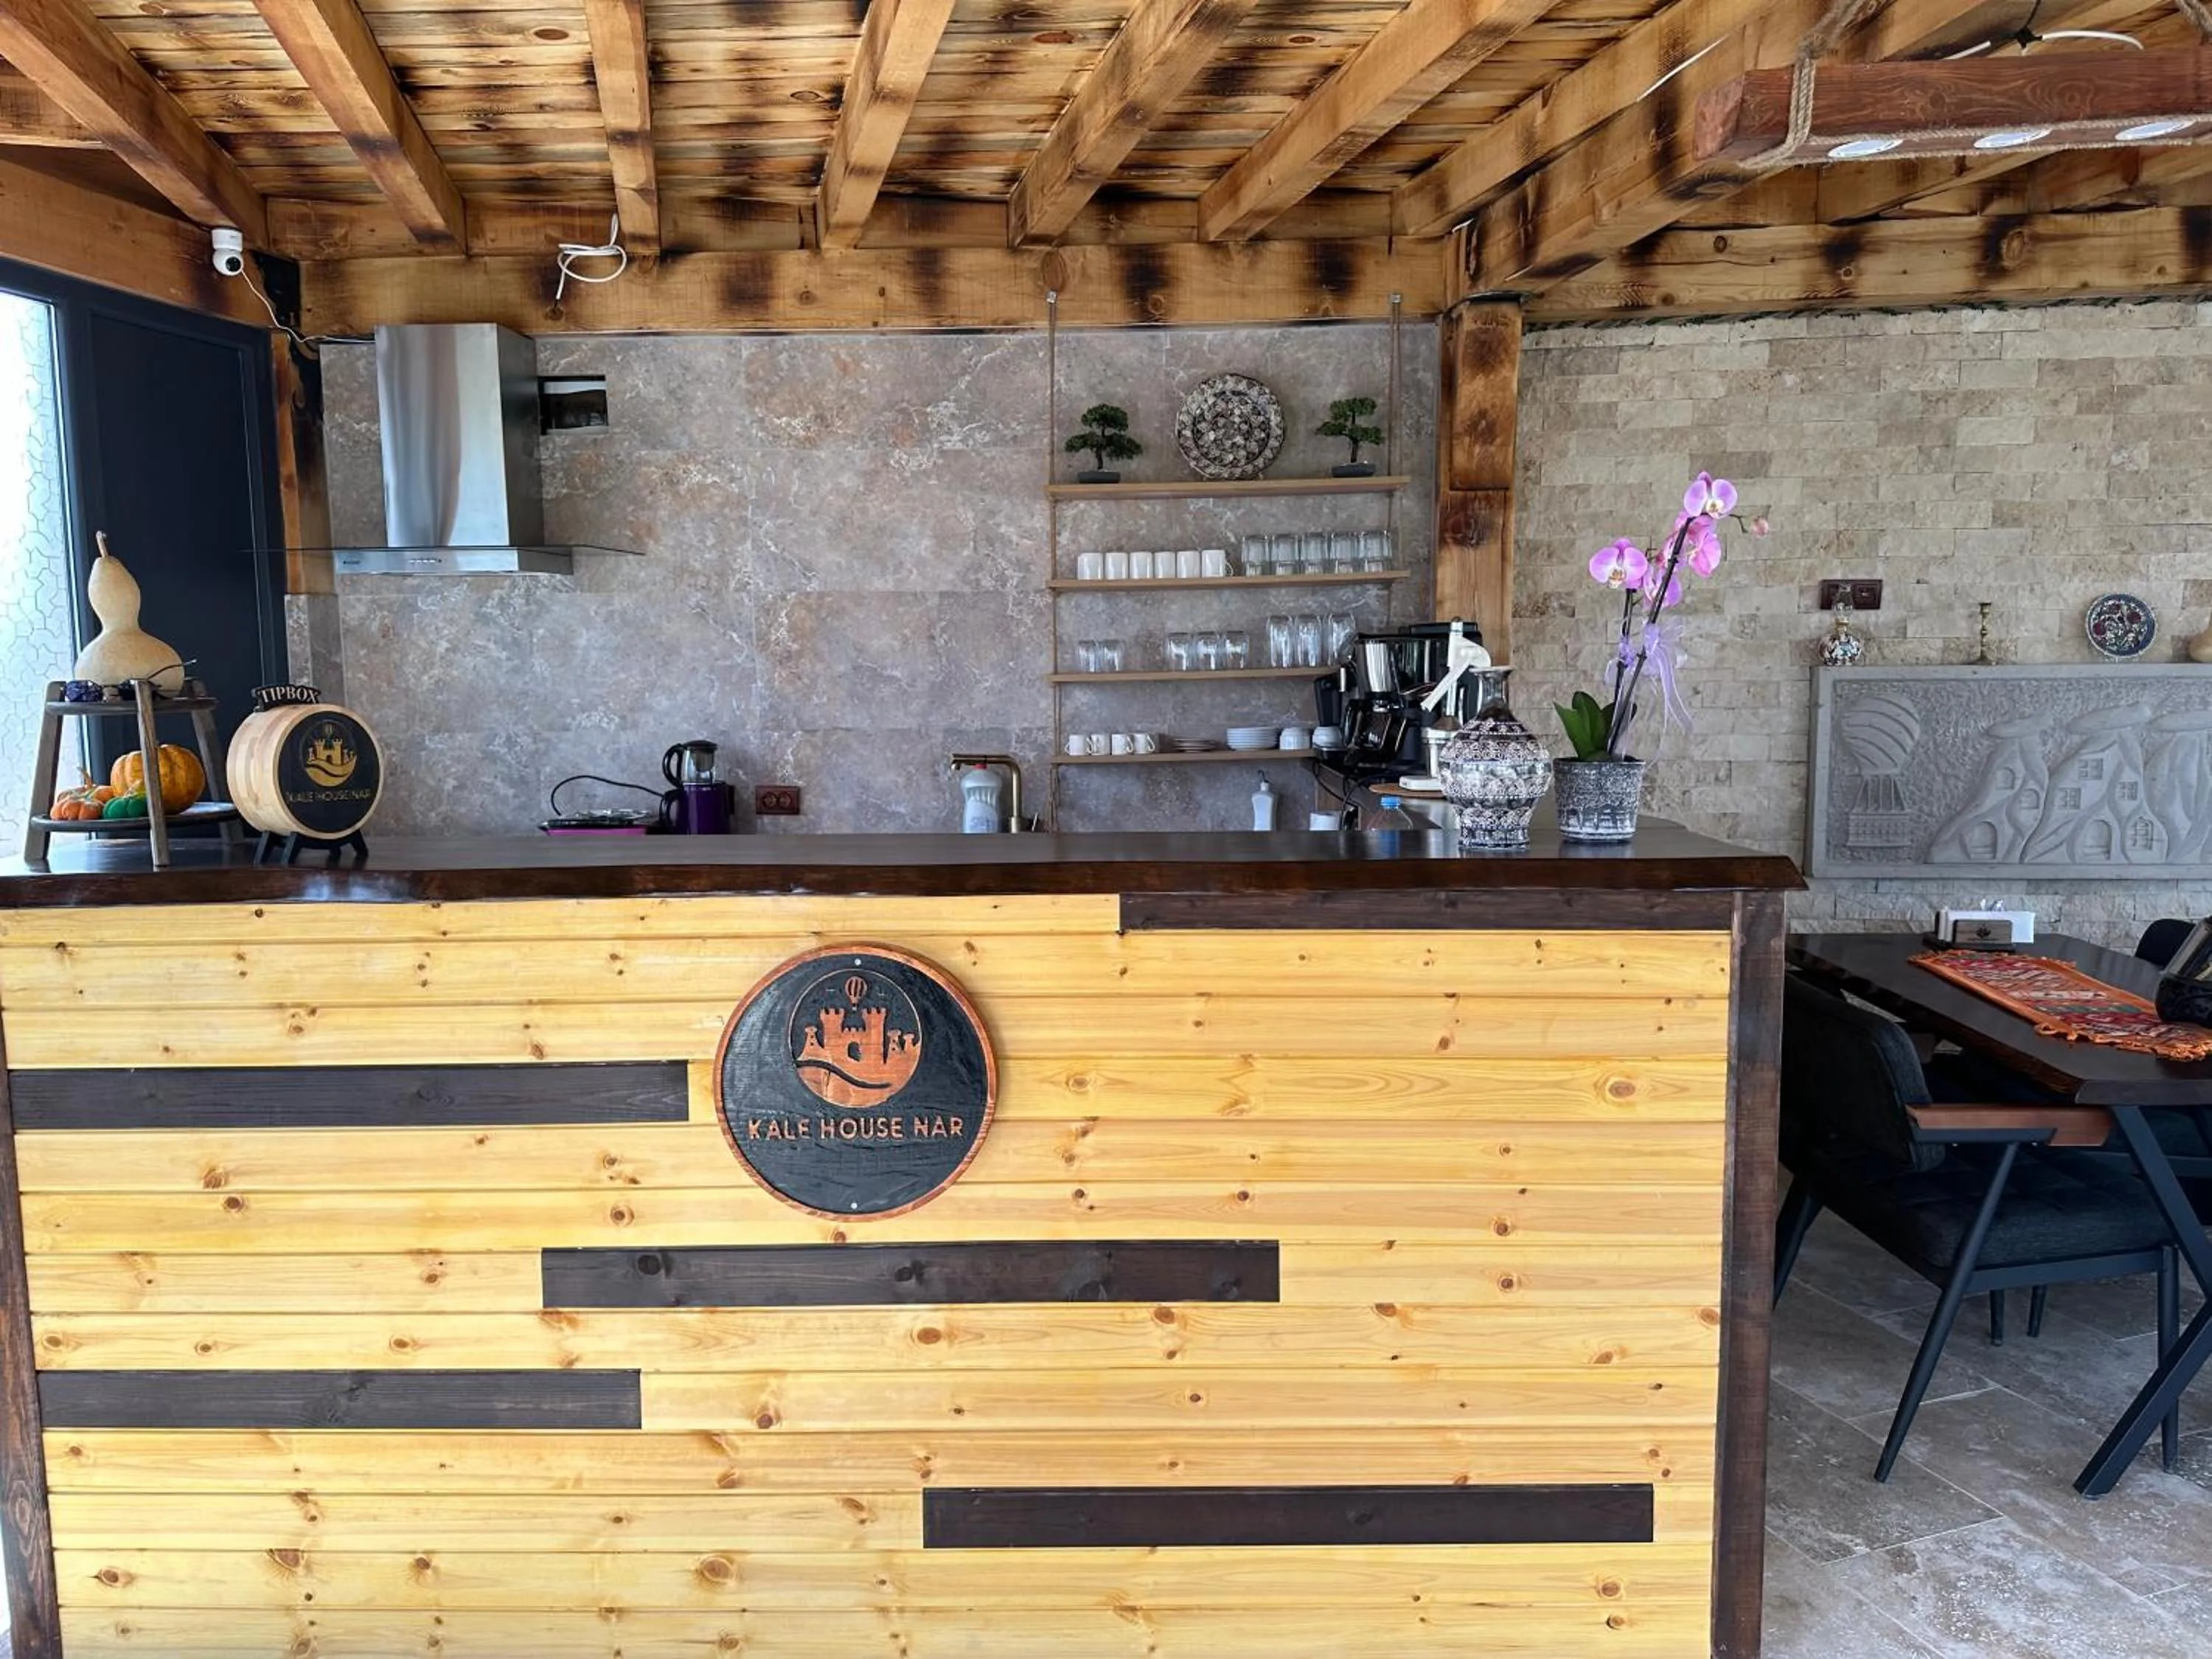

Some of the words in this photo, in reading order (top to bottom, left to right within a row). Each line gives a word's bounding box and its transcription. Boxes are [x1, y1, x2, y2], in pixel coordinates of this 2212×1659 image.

[257, 686, 318, 703] TIPBOX
[748, 1119, 811, 1140] KALE
[820, 1117, 903, 1140] HOUSE
[914, 1115, 964, 1138] NAR
